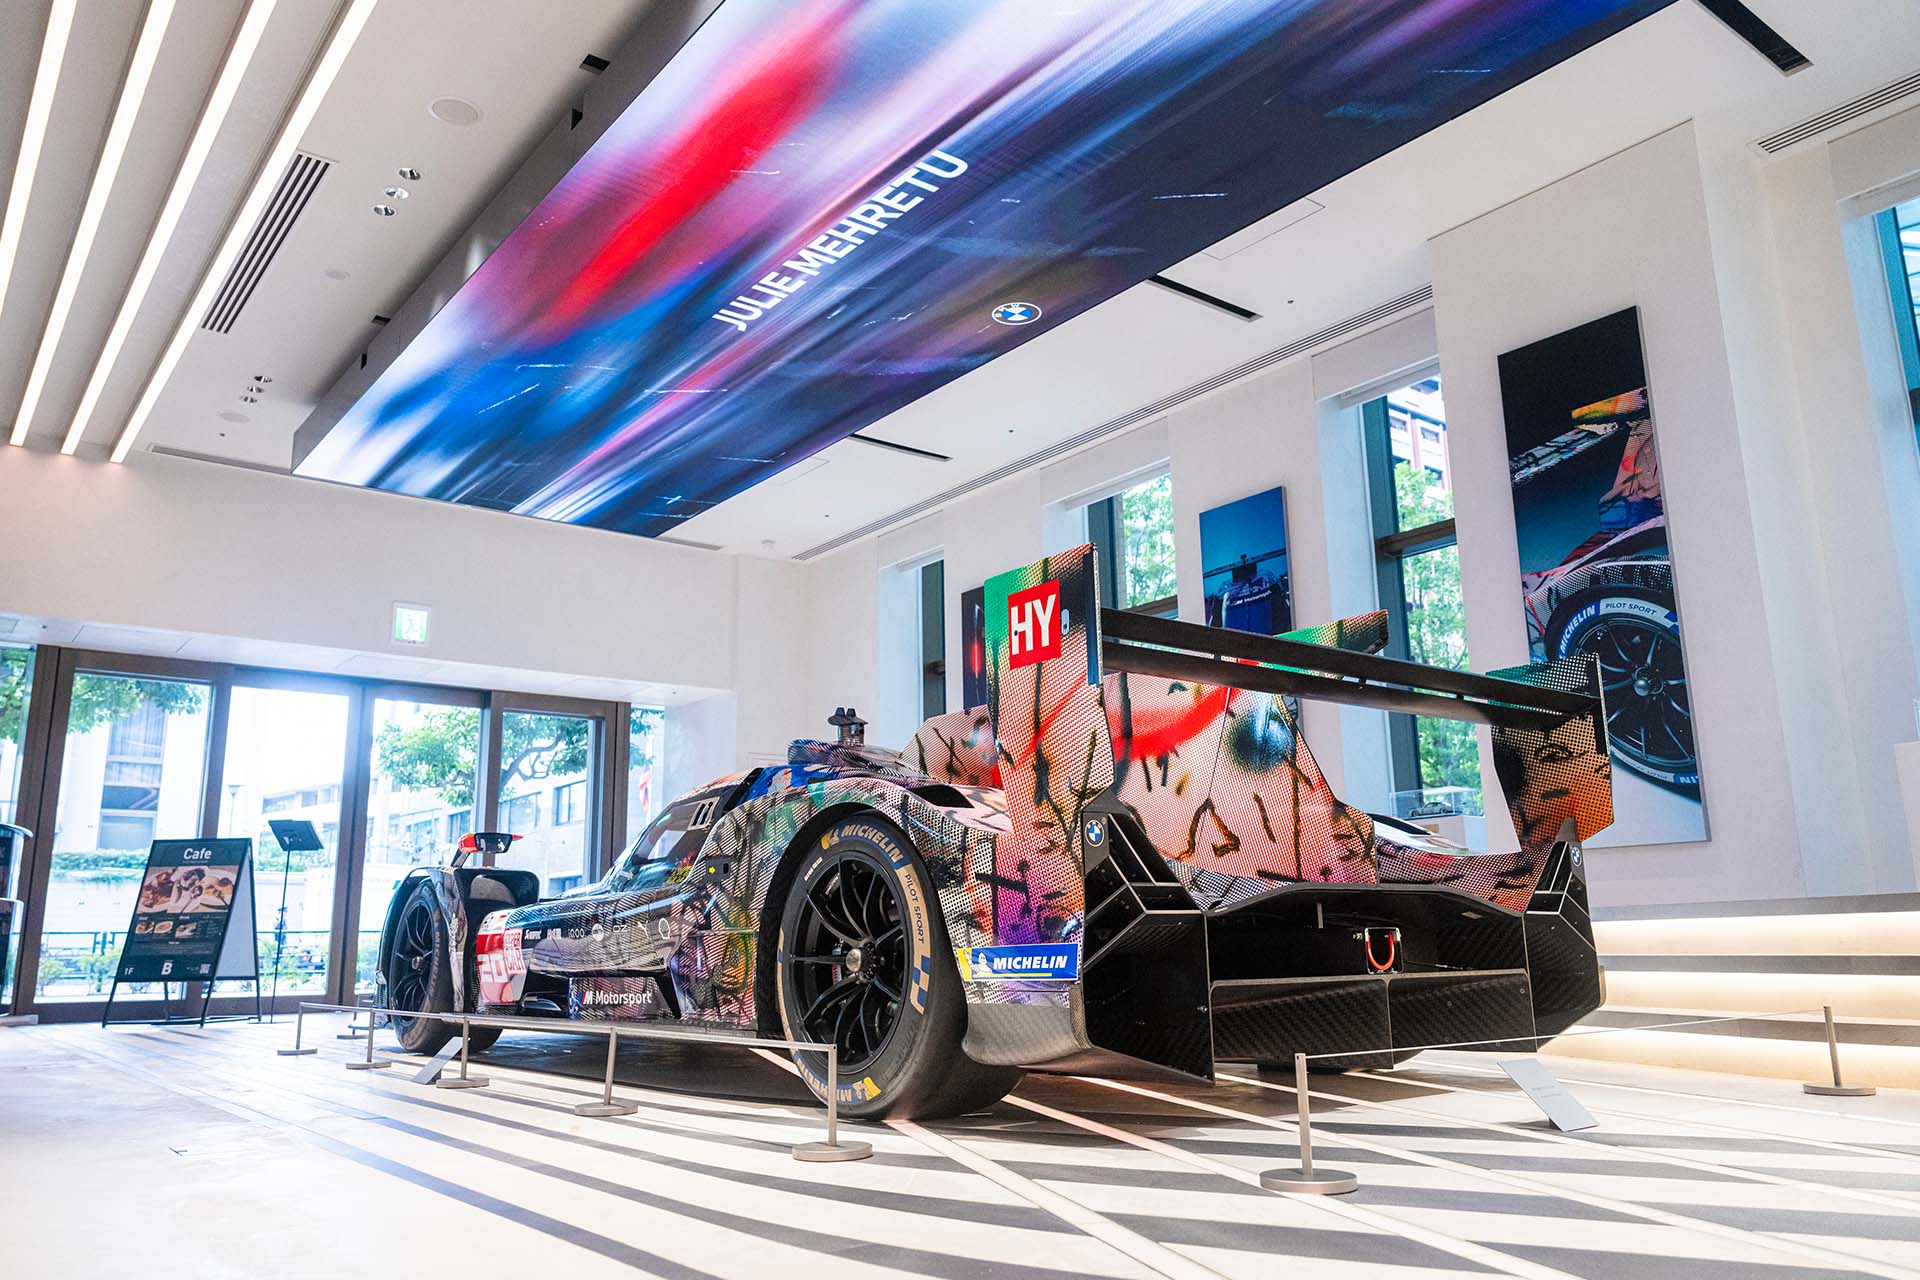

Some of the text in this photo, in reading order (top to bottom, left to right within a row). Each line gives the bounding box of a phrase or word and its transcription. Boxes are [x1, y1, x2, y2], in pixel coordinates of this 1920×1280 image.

[712, 150, 969, 332] JULIE MEHRETU
[1011, 594, 1056, 656] HY
[1605, 602, 1657, 616] PILOT SPORT
[1559, 605, 1596, 654] MICHELIN
[183, 848, 212, 860] Cafe
[841, 824, 905, 863] MICHELIN
[904, 873, 925, 945] PILOT SPORT
[477, 952, 509, 984] 20
[993, 955, 1068, 970] MICHELIN
[595, 989, 653, 1008] Motorsport
